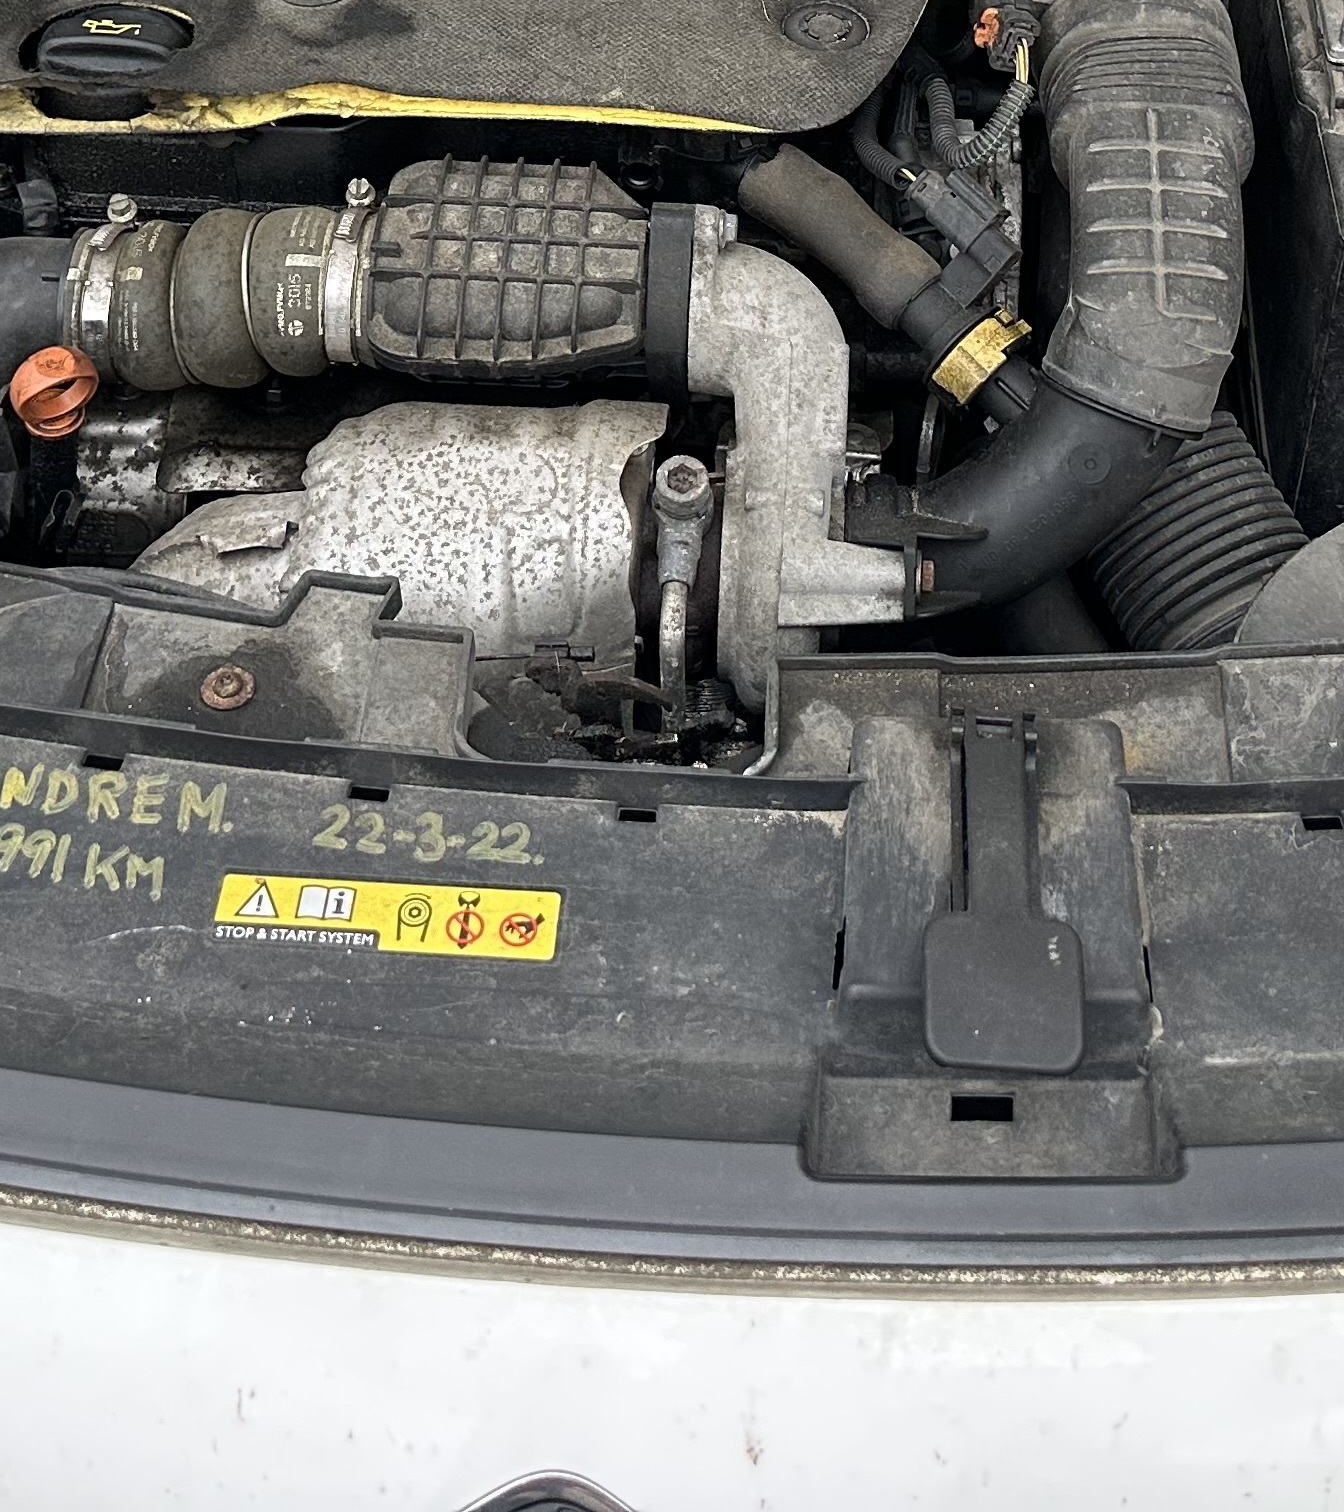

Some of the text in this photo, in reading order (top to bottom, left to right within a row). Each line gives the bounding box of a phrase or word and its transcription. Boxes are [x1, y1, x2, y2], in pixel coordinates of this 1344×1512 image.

[84, 842, 166, 902] KM
[215, 926, 375, 946] STOP & START SYSTEM
